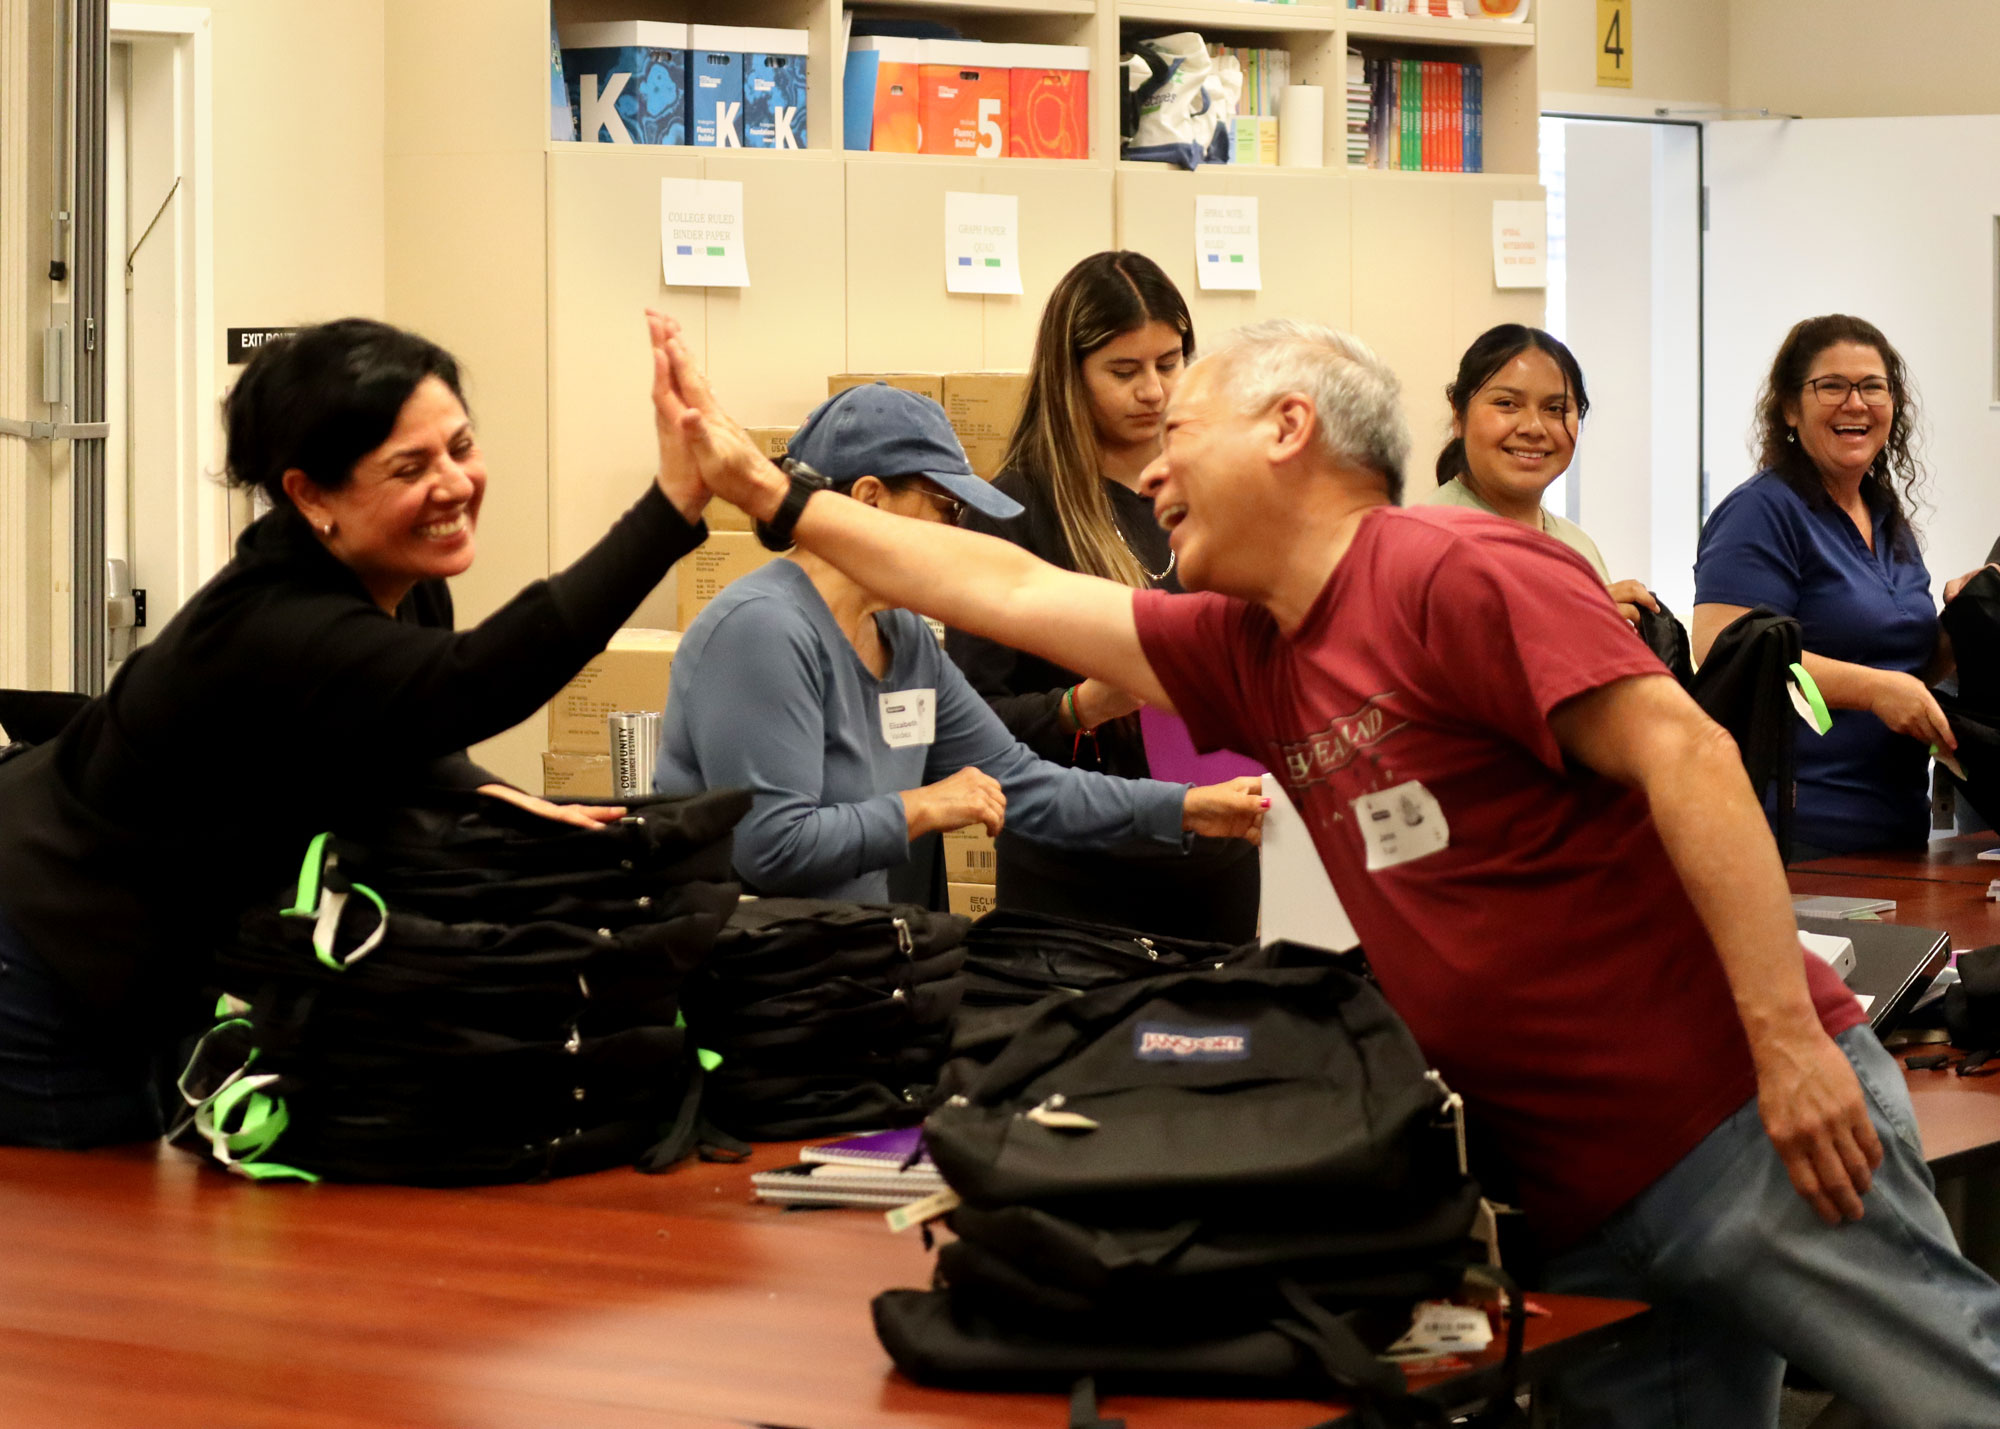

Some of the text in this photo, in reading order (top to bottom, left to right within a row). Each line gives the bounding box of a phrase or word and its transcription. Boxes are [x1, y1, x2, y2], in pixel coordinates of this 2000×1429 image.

[1604, 9, 1624, 69] 4
[580, 72, 632, 144] K
[716, 101, 742, 148] K
[775, 106, 798, 149] K
[976, 98, 1002, 158] 5
[668, 212, 735, 225] COLLEGE RULED
[673, 229, 731, 241] BINDER PAPER
[241, 332, 264, 348] EXIT
[619, 727, 630, 789] COMMUNITY
[628, 727, 637, 789] RESOURCE FESTIVAL
[970, 904, 988, 913] USA
